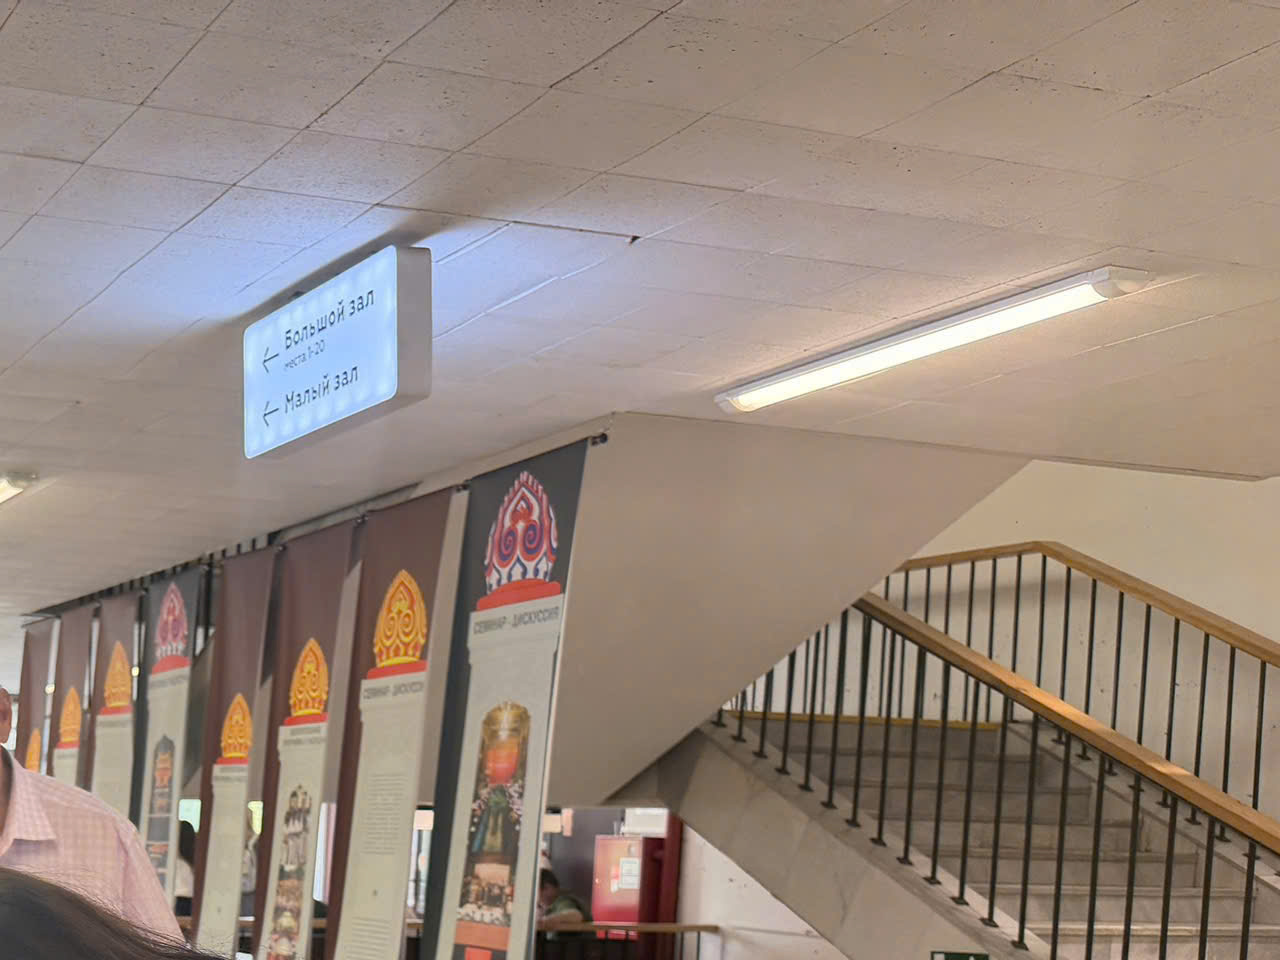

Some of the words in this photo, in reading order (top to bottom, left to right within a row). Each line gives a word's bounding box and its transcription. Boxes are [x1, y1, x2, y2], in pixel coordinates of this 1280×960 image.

[284, 299, 345, 351] Большой
[349, 289, 375, 316] зал
[284, 373, 330, 414] Малый
[333, 365, 359, 392] зал
